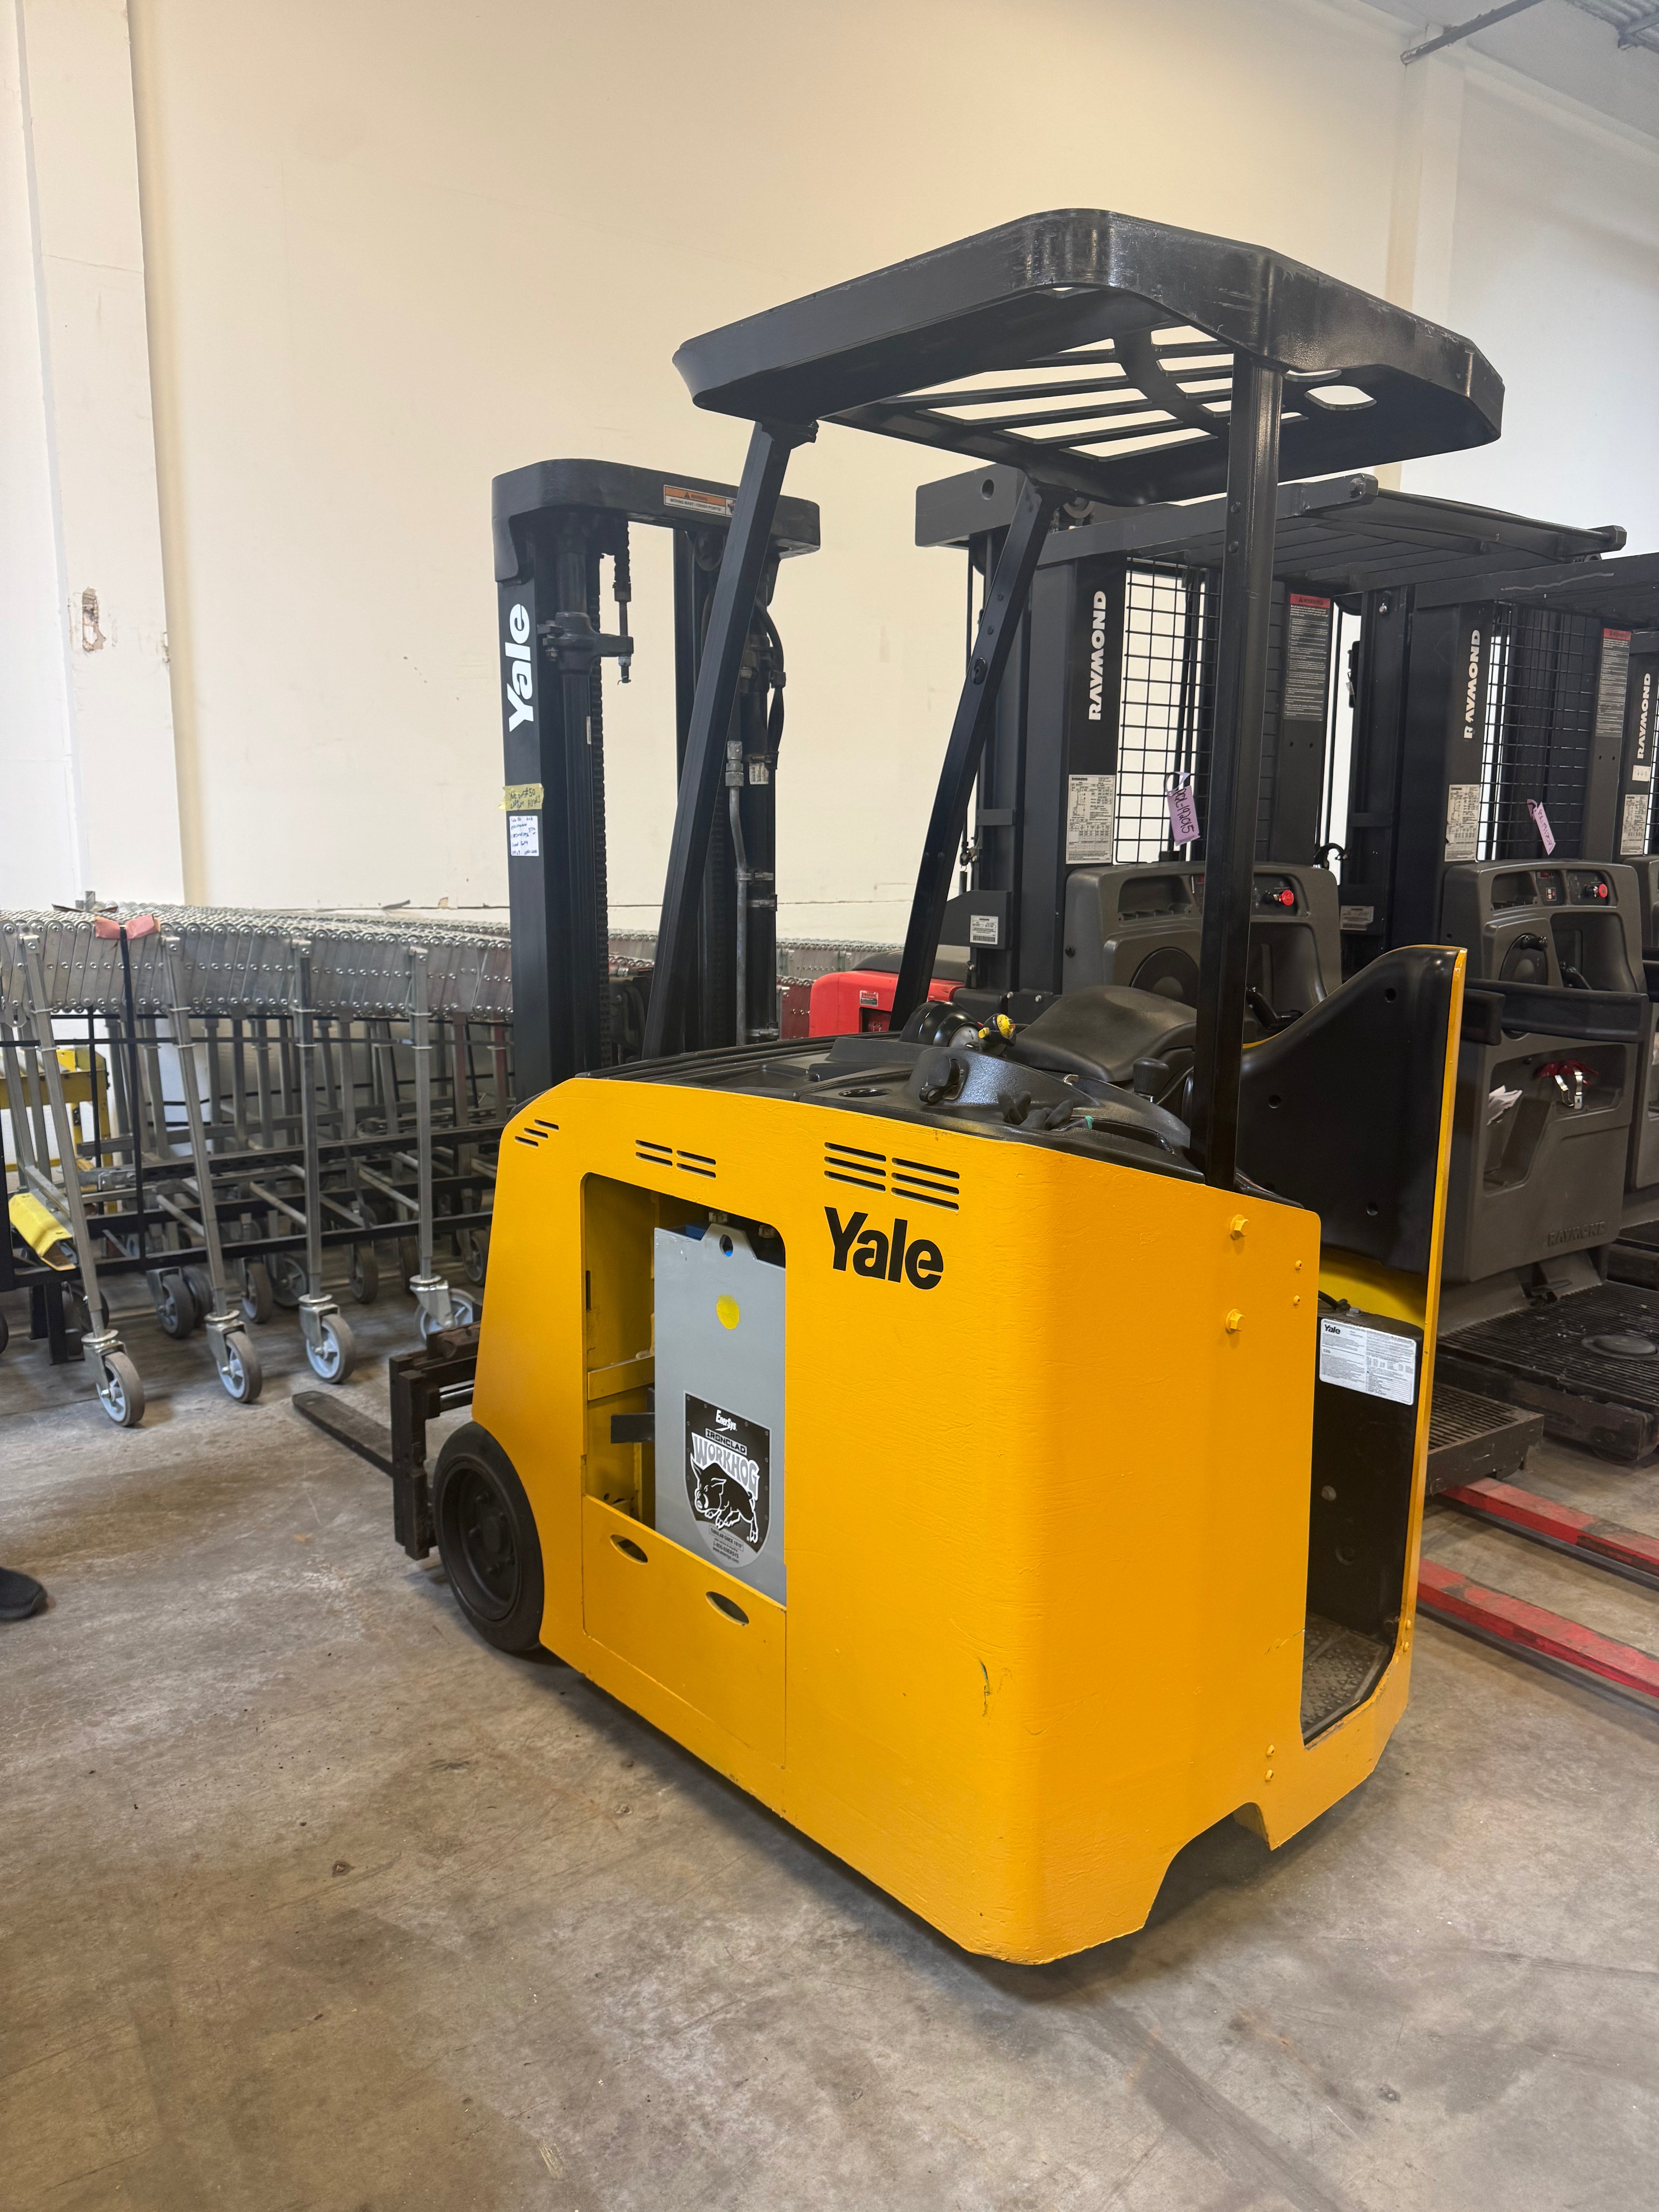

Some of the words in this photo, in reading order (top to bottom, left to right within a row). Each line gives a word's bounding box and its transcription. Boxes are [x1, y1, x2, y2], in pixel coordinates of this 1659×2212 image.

[505, 604, 534, 732] Yale
[1088, 591, 1106, 721] RAYMOND
[1464, 629, 1481, 739] RAYMOND
[1637, 673, 1651, 759] RAYMOND
[823, 1206, 944, 1290] Yale
[1547, 1221, 1606, 1246] RAYMOND
[1324, 1324, 1341, 1335] Yale
[706, 1430, 746, 1453] IRONCLAD
[715, 1409, 737, 1431] EnerSys
[692, 1433, 759, 1501] WORKHOG
